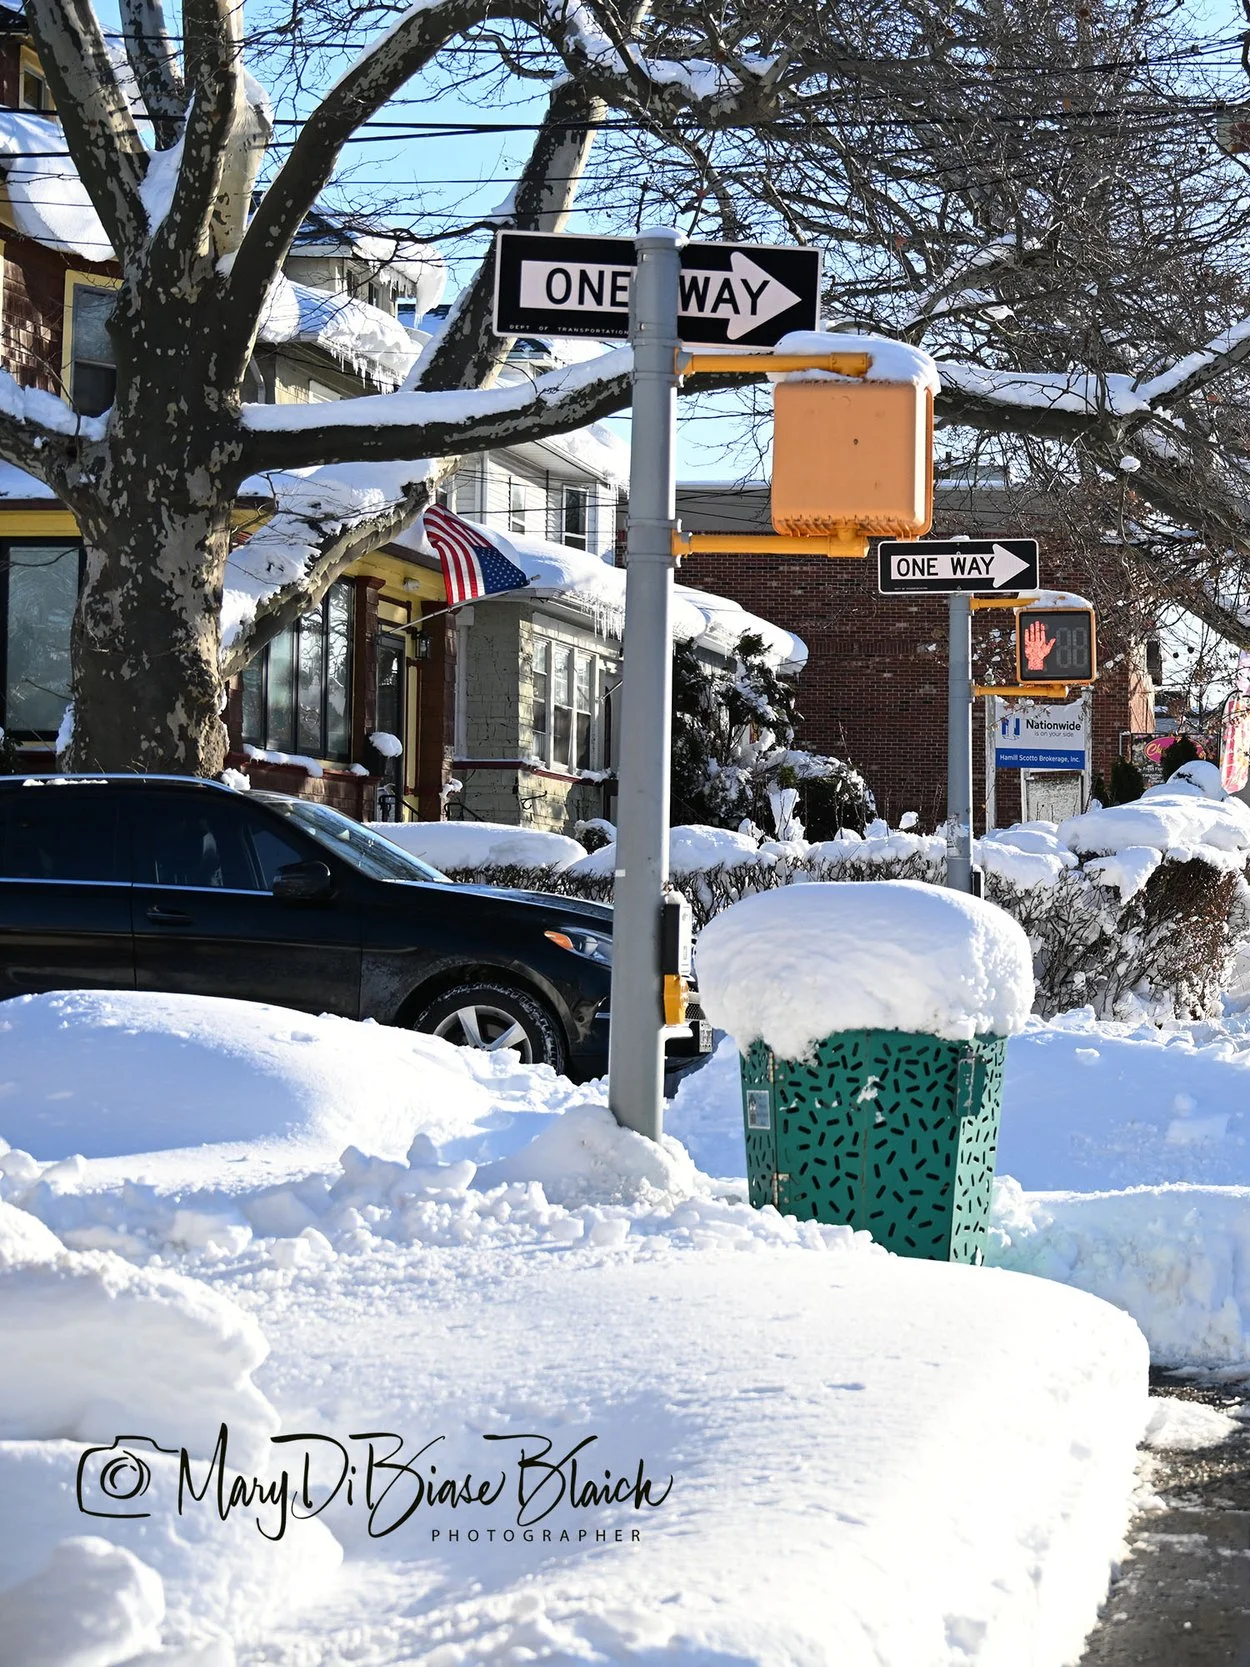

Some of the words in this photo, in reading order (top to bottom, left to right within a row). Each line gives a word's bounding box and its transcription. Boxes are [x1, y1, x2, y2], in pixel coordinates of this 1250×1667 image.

[545, 267, 629, 307] ONE
[679, 274, 770, 316] WAY
[558, 326, 629, 335] TRANSPORTATION
[896, 557, 939, 577] ONE
[950, 556, 995, 576] WAY
[1026, 719, 1081, 731] Nationwide
[1039, 755, 1069, 763] Brokerage,
